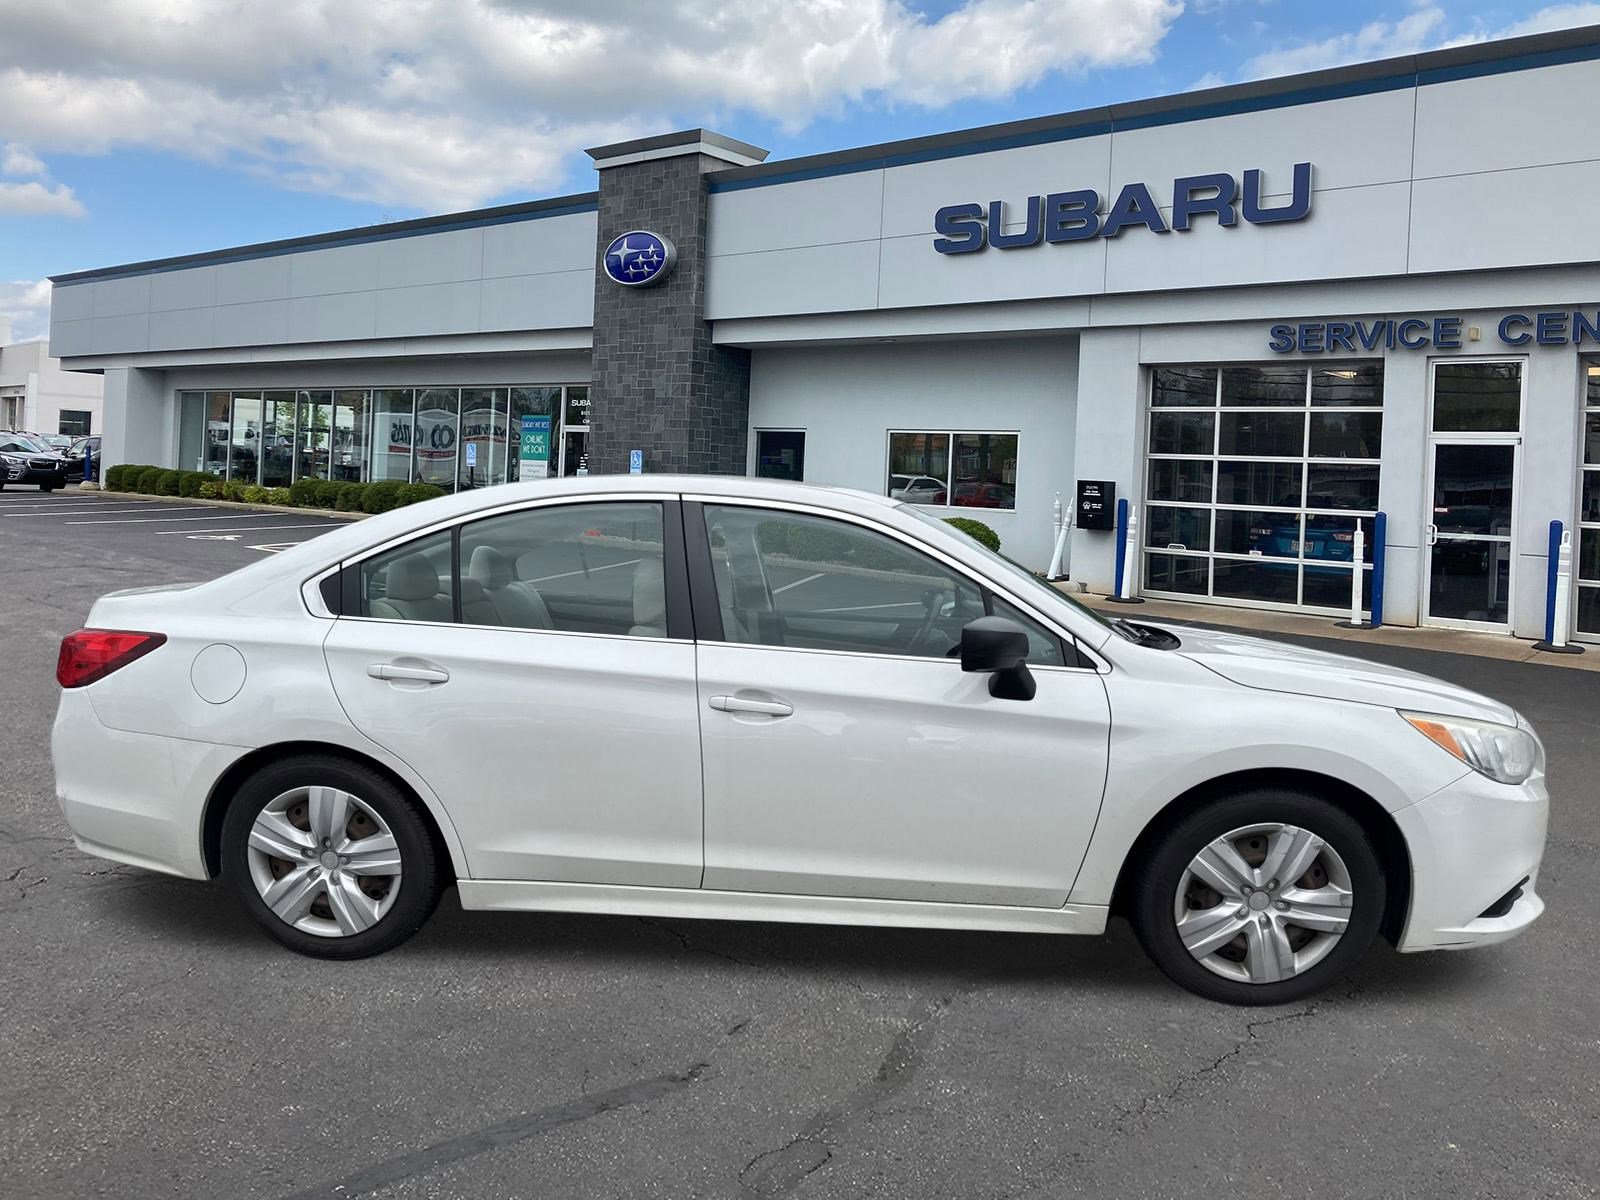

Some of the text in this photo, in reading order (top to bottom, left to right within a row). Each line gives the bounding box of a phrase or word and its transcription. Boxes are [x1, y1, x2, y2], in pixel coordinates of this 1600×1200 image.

[934, 162, 1313, 255] SUBARU
[1269, 311, 1600, 352] SERVICE CEN
